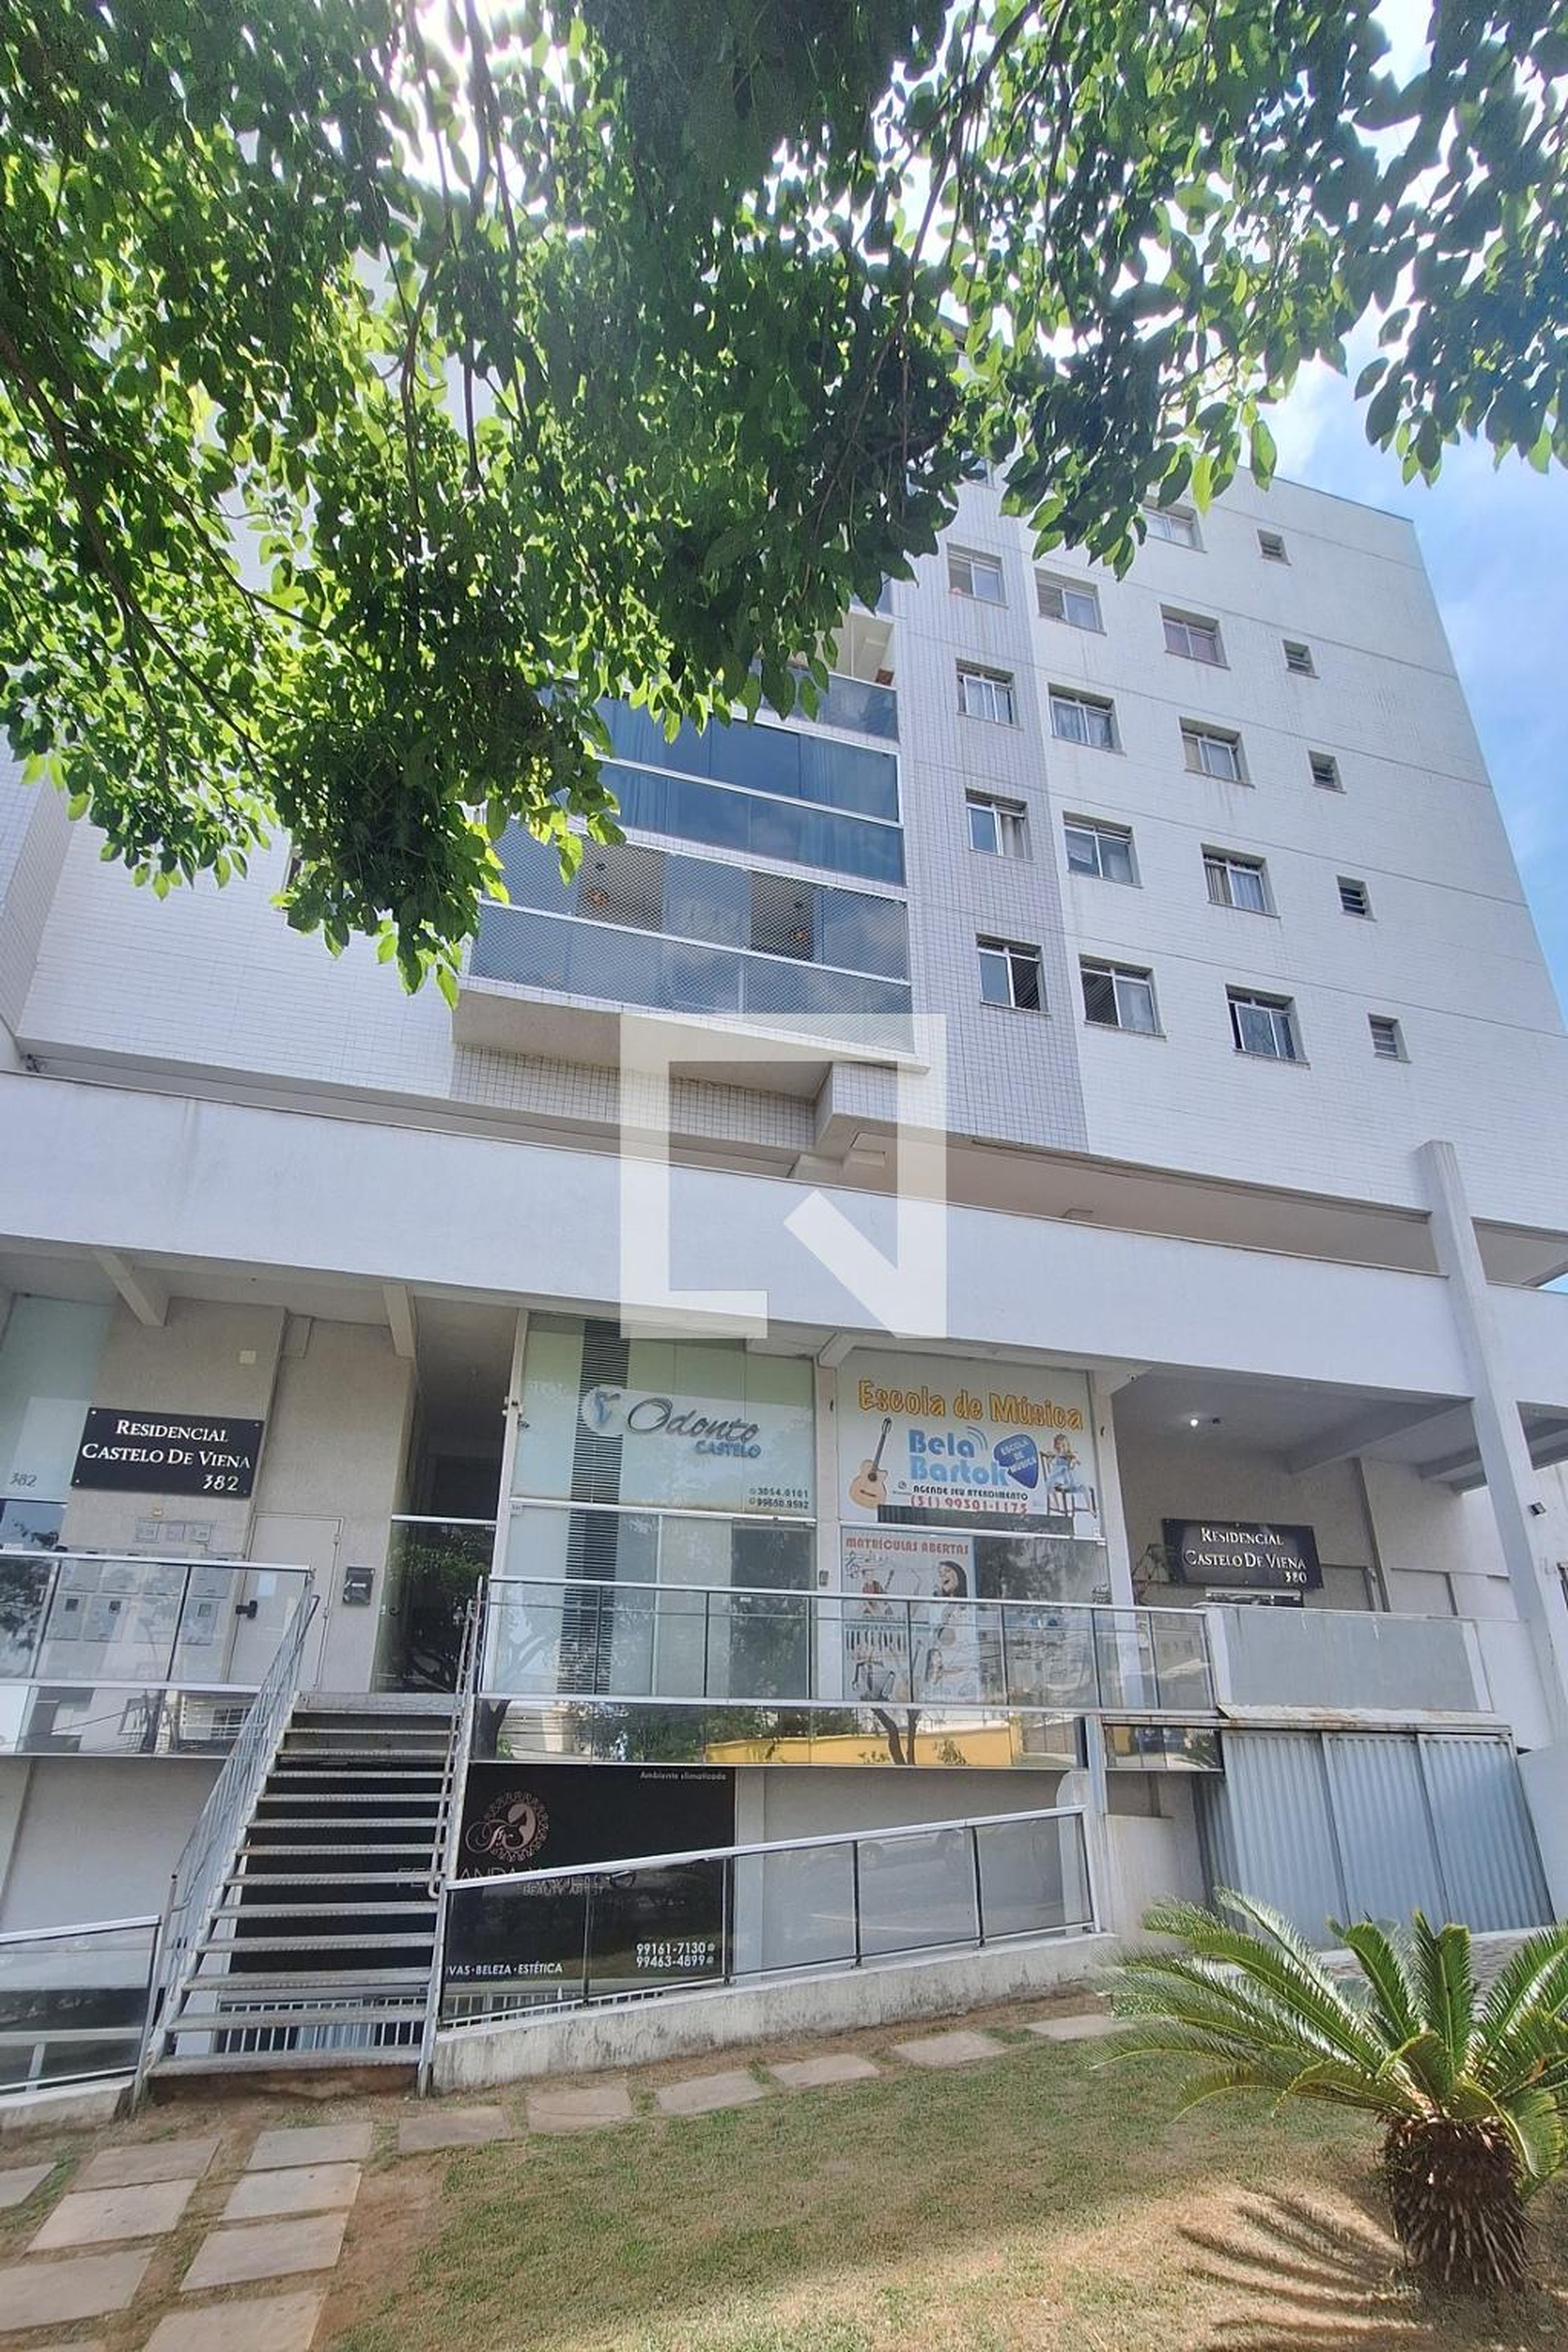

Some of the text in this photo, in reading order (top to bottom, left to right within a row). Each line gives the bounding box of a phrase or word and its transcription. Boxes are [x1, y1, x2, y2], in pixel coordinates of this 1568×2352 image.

[858, 1379, 1083, 1430] Escola de Música
[628, 1397, 760, 1443] Odonto
[115, 1419, 229, 1443] RESIDENCIAL
[695, 1440, 762, 1459] CASTELO
[908, 1430, 975, 1459] Bela
[82, 1443, 250, 1469] CASTELO DE VIENA
[10, 1472, 38, 1488] 382
[203, 1474, 239, 1491] 382
[1201, 1527, 1284, 1546] RESIDENCIAL
[921, 1542, 969, 1555] ABERTAS
[1183, 1550, 1243, 1567] CASTELO
[1266, 1555, 1306, 1570] VIENA
[636, 1942, 706, 1956] 99161-7130
[518, 1960, 564, 1974] ESTÉTICA
[636, 1954, 706, 1968] 99463-4899
